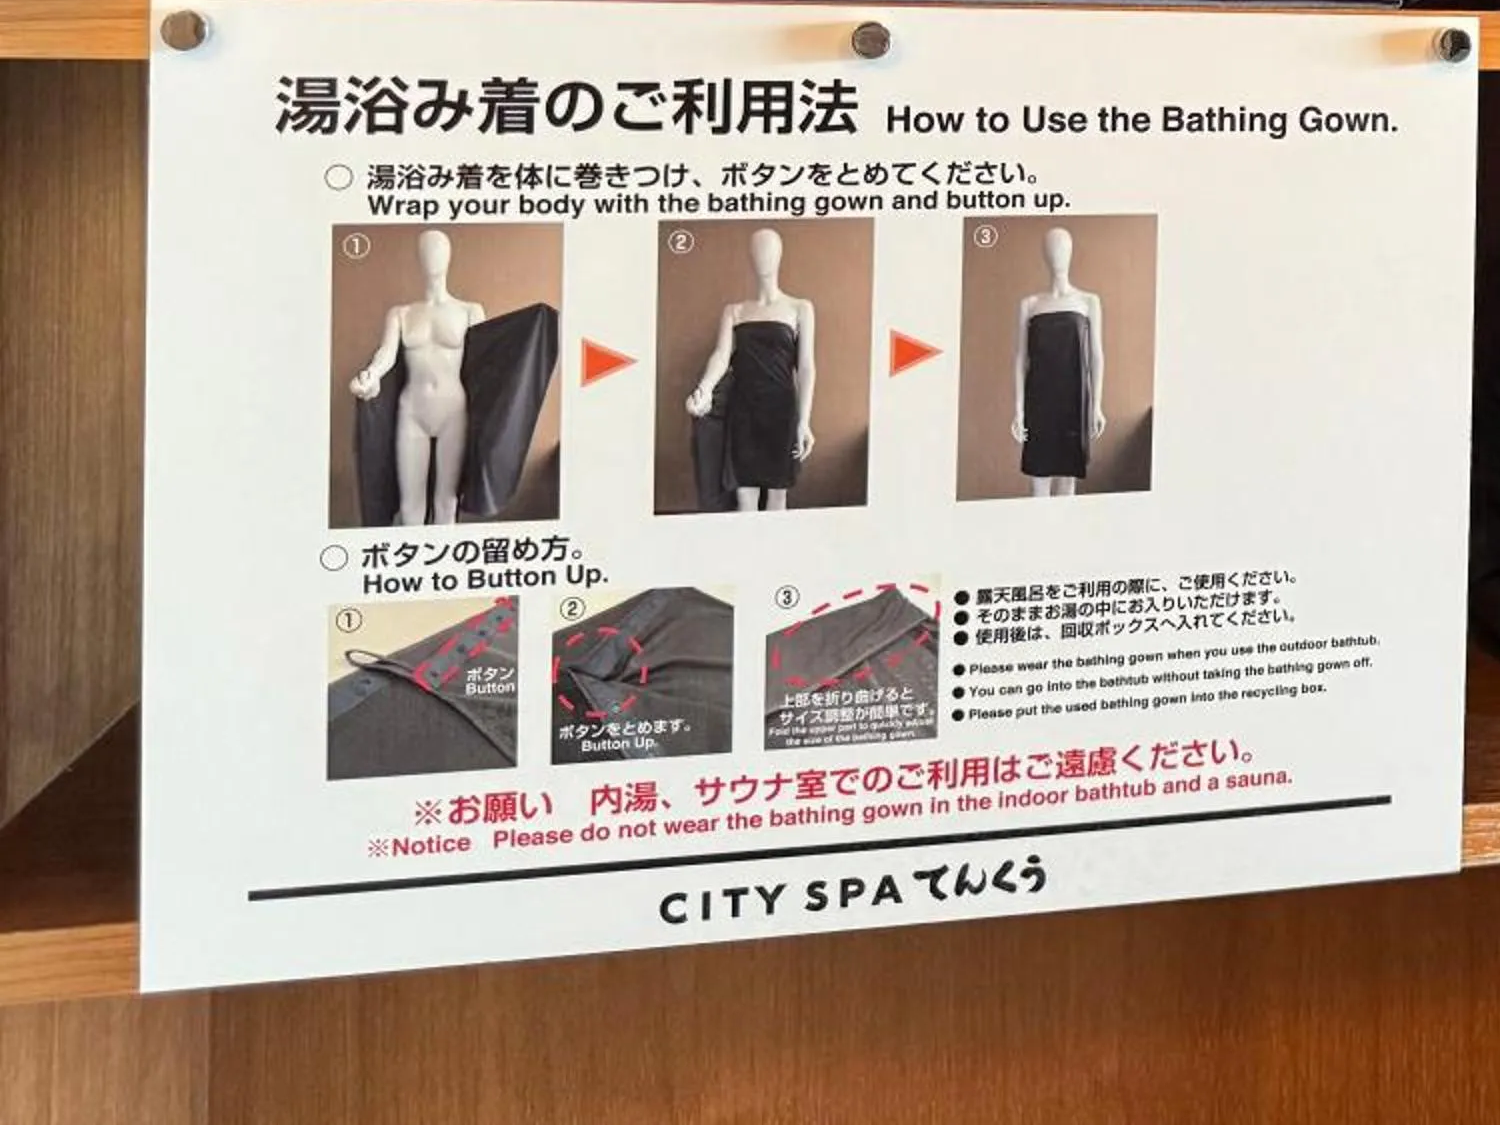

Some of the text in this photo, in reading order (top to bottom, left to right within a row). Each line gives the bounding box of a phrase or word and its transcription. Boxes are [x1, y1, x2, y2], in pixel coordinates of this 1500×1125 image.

[276, 76, 858, 135] 湯浴み着のご利用法
[888, 105, 1397, 139] How to Use the Bathing Gown.
[368, 161, 1036, 190] 湯浴み着を体に巻きつけ、ボタンをとめてください。
[368, 190, 1070, 220] Wrap your body with the bathing gown and button up.
[362, 535, 581, 568] ボタンの留め方。
[364, 564, 608, 594] How to Button Up.
[970, 635, 1380, 675] Please wear the bathing gown when you use the outdoor bathtub.
[466, 682, 515, 695] Button
[467, 667, 515, 681] ボタン
[969, 657, 1372, 697] You can go into the bathtub without taking the bathing gown off.
[969, 683, 1327, 720] Please put the used bathing gown into the recycling box.
[581, 739, 630, 752] Button
[494, 829, 573, 848] Please
[580, 823, 610, 841] do
[619, 820, 656, 838] not
[664, 818, 719, 835] wear
[727, 813, 762, 830] the
[770, 806, 854, 827] bathing
[863, 803, 922, 821] gown
[931, 797, 949, 813] in
[957, 795, 992, 811] the
[999, 789, 1068, 808] indoor
[1076, 780, 1156, 801] bathtub
[1163, 776, 1200, 794] and
[1208, 777, 1219, 791] a
[1227, 771, 1292, 789] sauna.
[912, 855, 1047, 901] てんくう
[659, 875, 903, 924] CITY SPA
